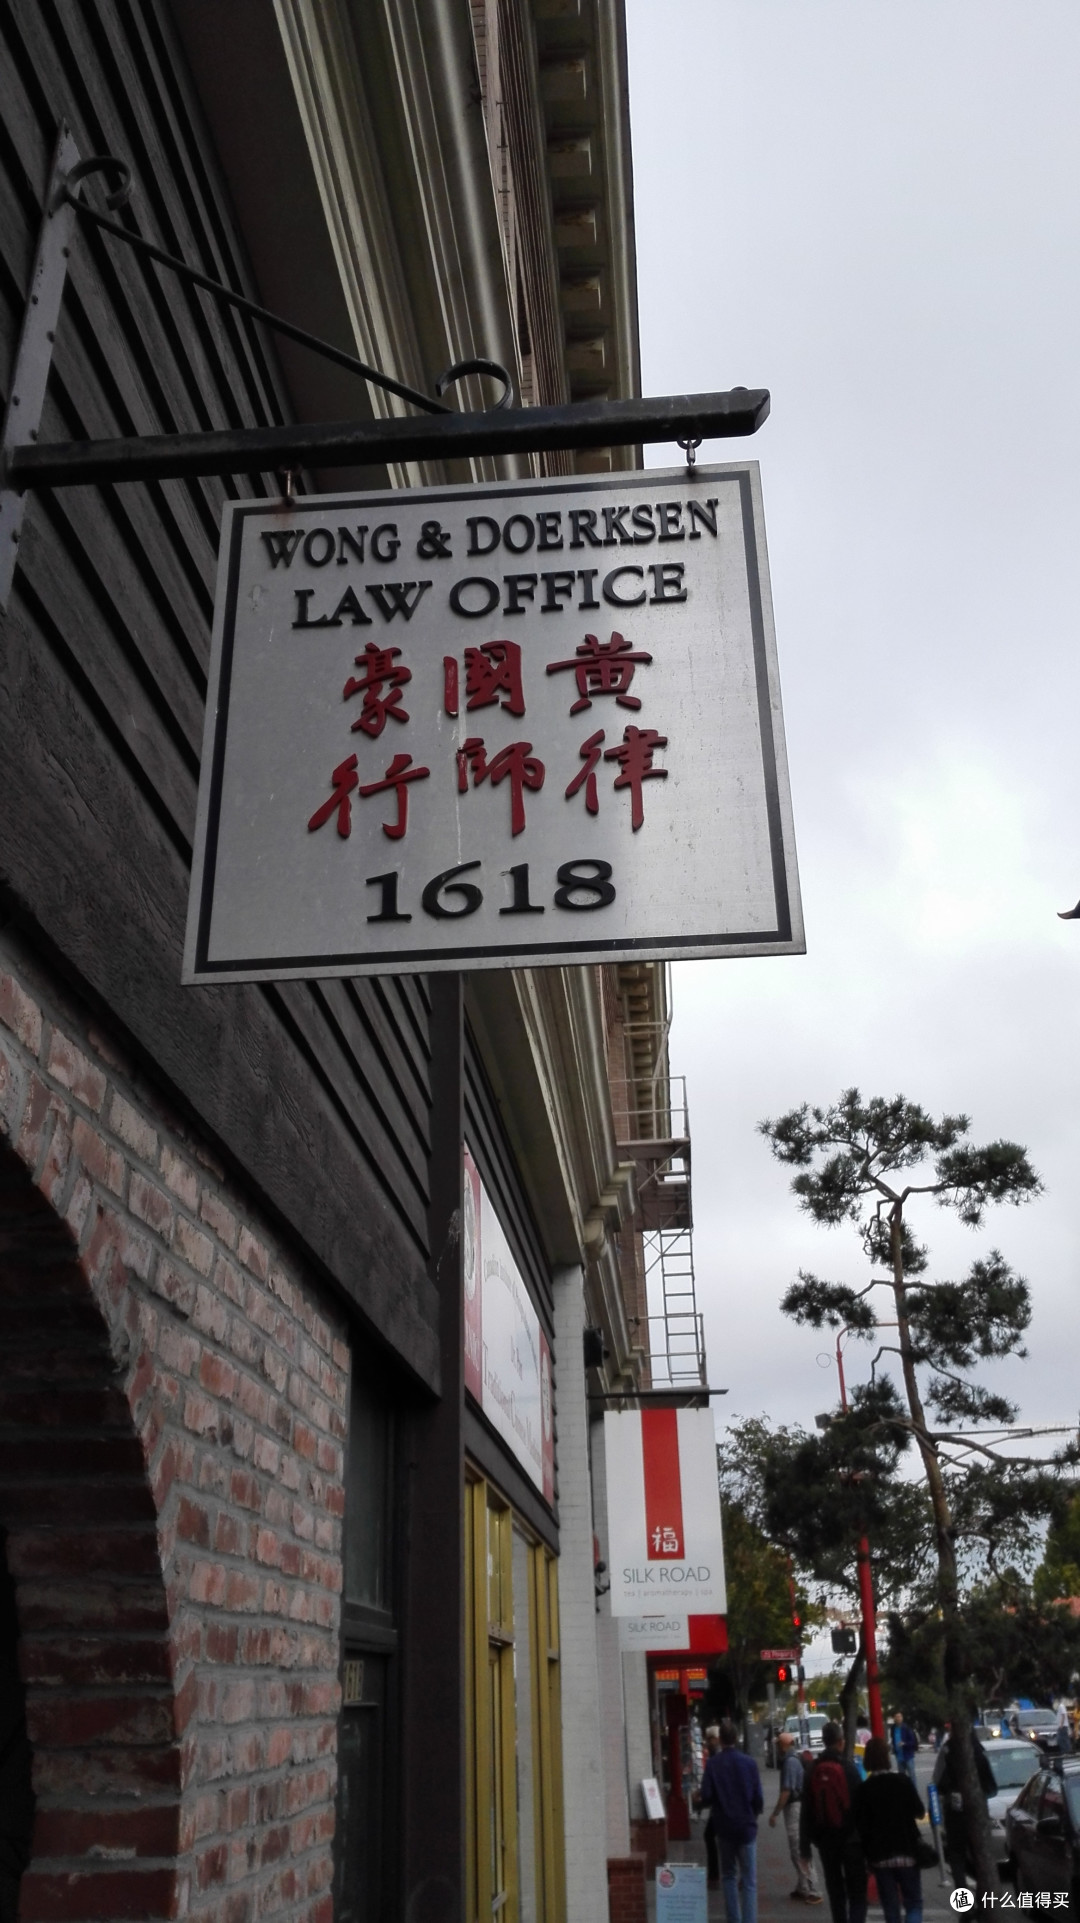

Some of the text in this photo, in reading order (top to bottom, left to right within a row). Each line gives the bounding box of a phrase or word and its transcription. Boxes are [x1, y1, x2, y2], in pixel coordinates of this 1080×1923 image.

[262, 498, 720, 568] WONG & DOERKSEN
[292, 562, 689, 628] LAW OFFICE
[366, 859, 616, 923] 1618
[652, 1526, 679, 1553] 福
[623, 1566, 711, 1584] SILK ROAD
[628, 1621, 681, 1633] SILK ROAD
